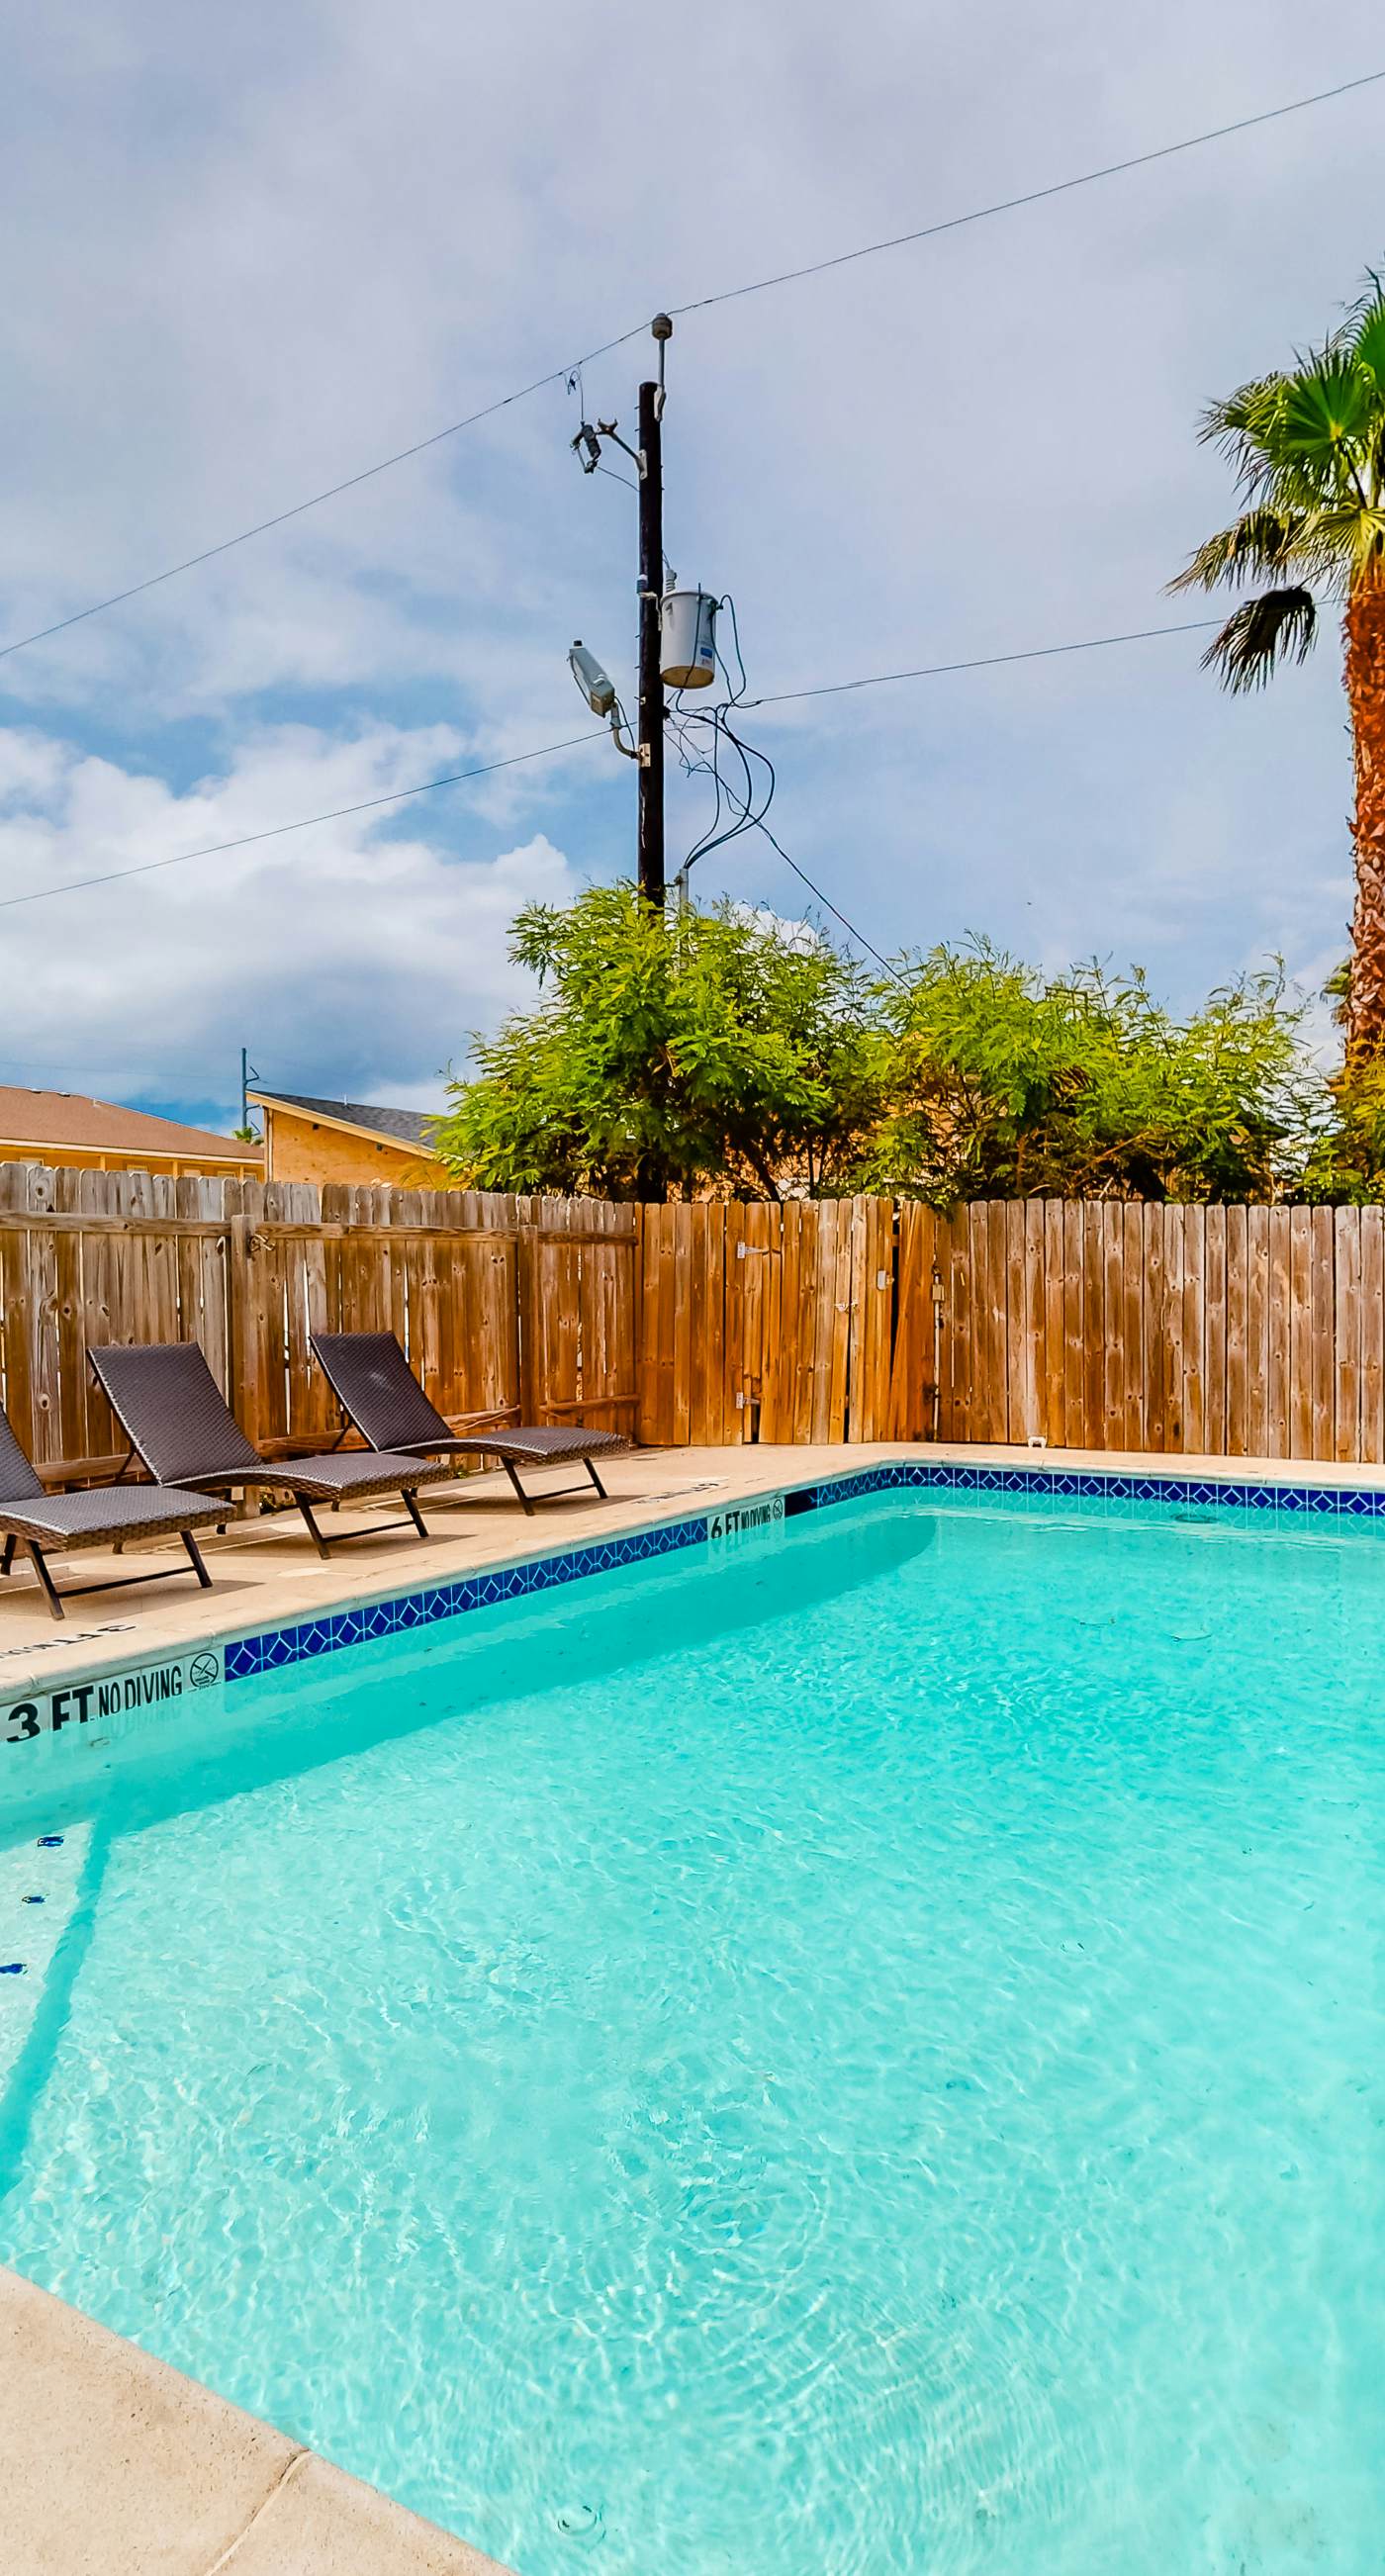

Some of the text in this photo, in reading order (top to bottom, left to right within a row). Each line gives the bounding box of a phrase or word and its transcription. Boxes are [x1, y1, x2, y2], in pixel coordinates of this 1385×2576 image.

[711, 1504, 771, 1539] 6 FT NO DIVING
[6, 1665, 182, 1743] 3 FT NO DIVING
